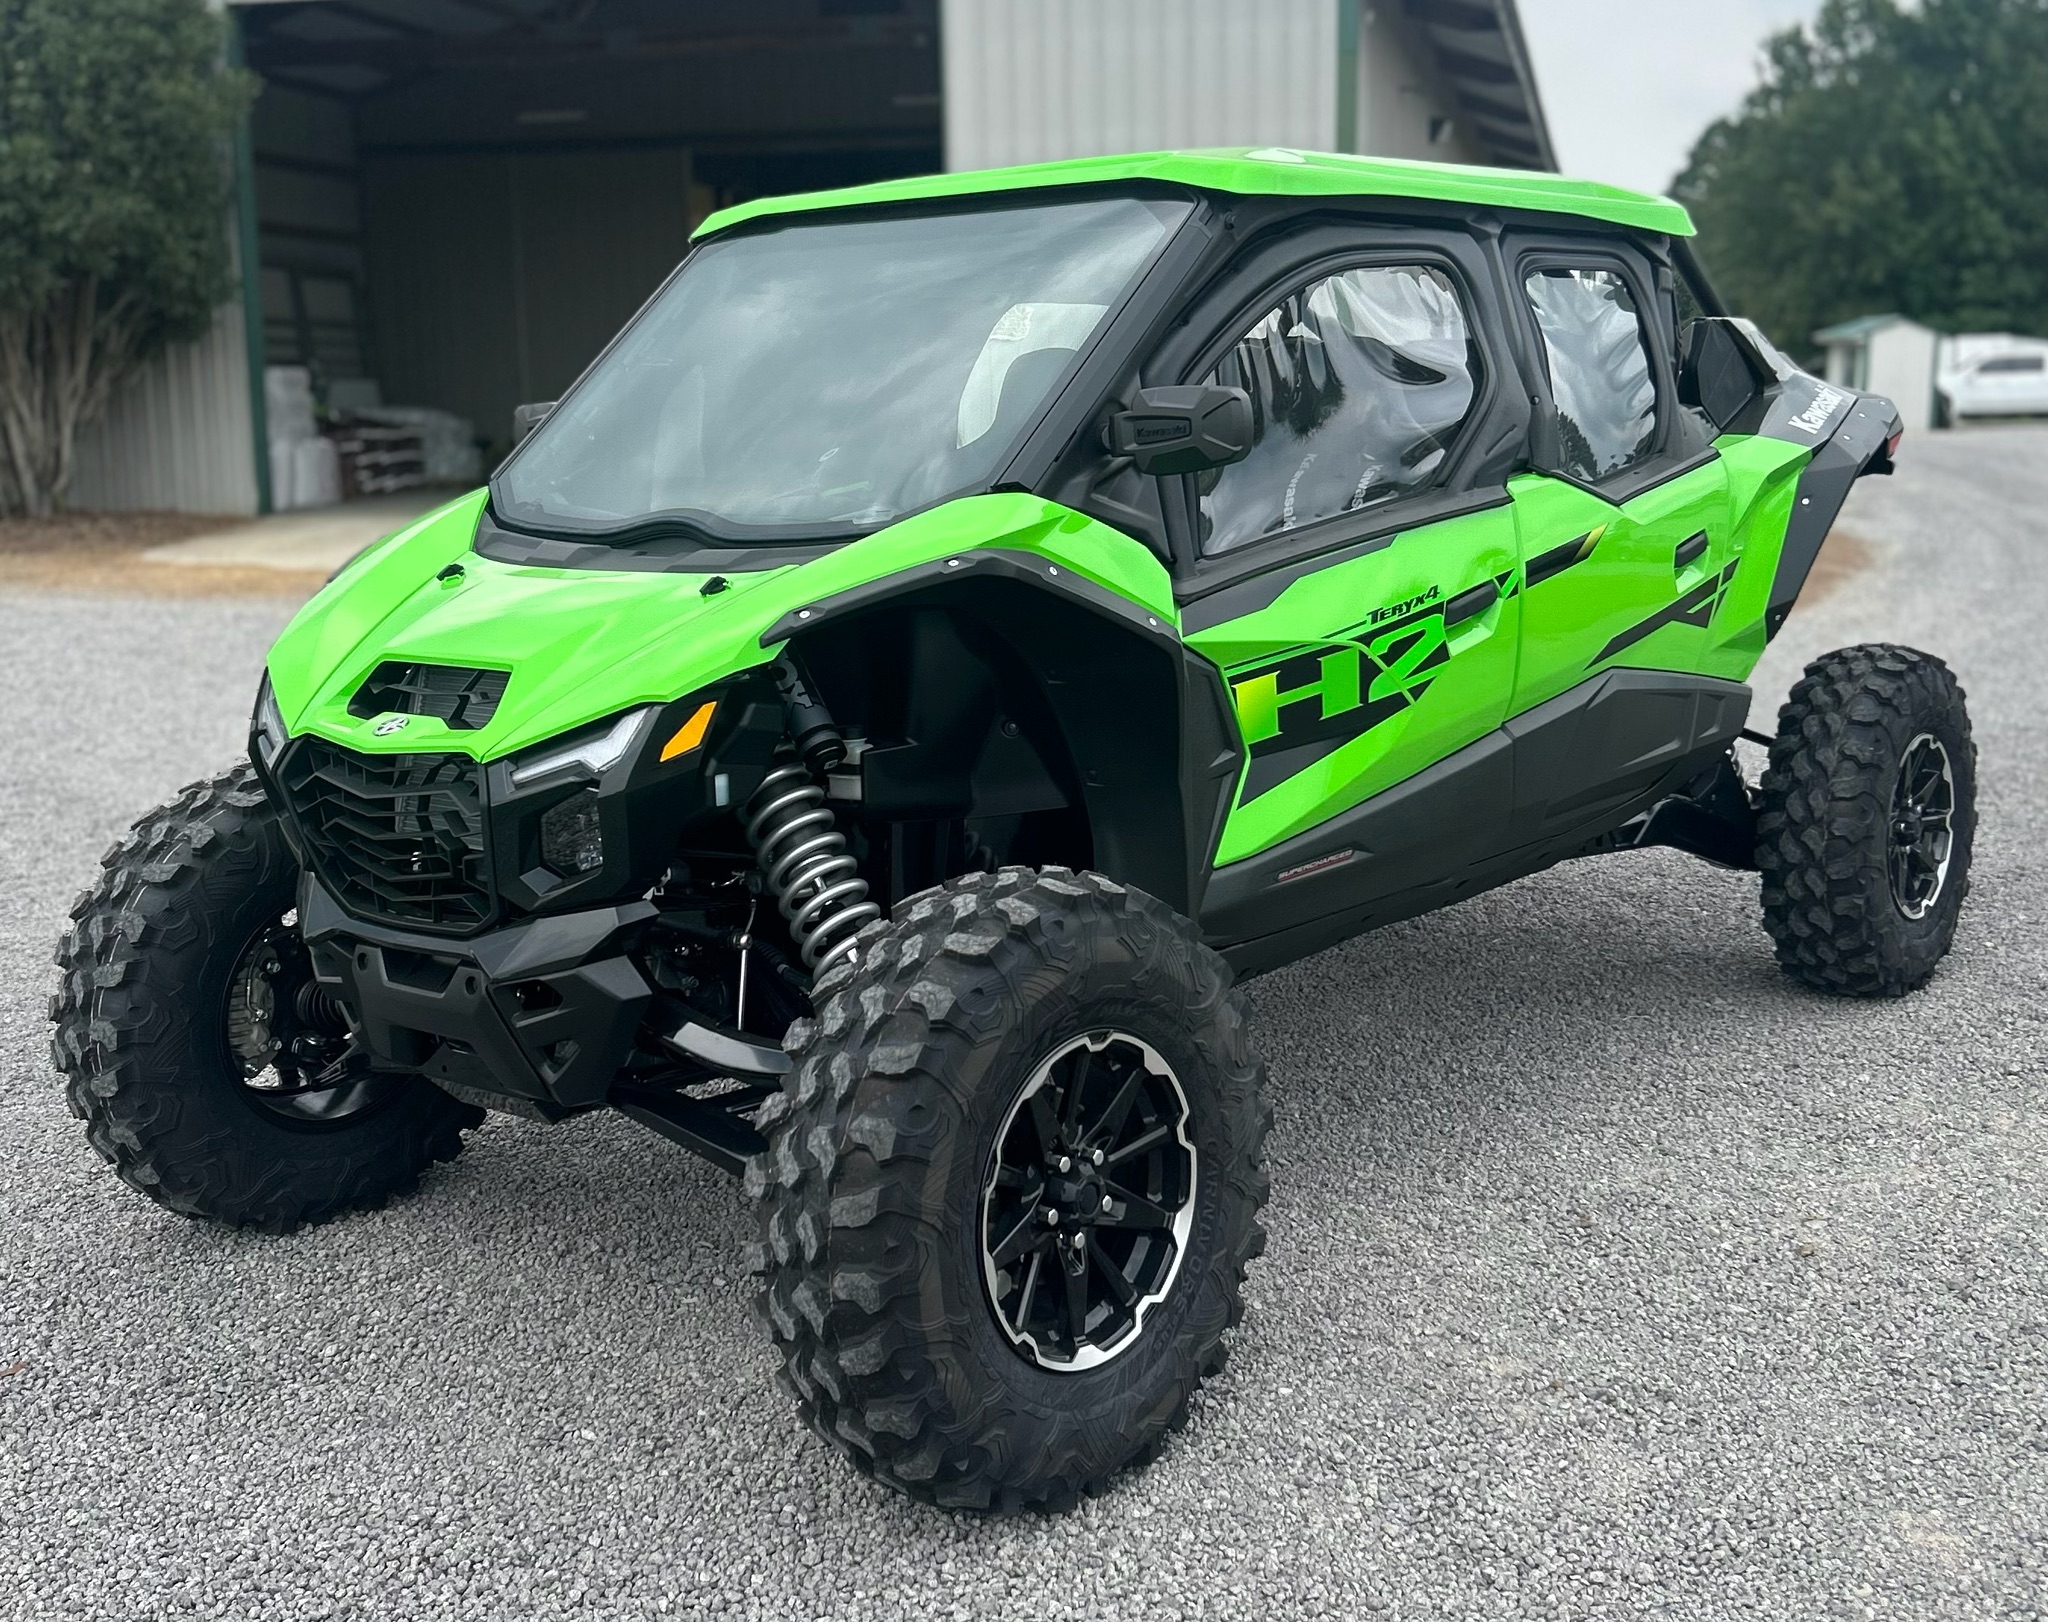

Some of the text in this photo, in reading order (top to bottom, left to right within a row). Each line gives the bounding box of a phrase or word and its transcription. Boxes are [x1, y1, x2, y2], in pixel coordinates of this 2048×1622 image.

[1136, 423, 1188, 438] Kawasaki
[1788, 384, 1844, 435] Kawasaki
[1231, 613, 1450, 744] H2
